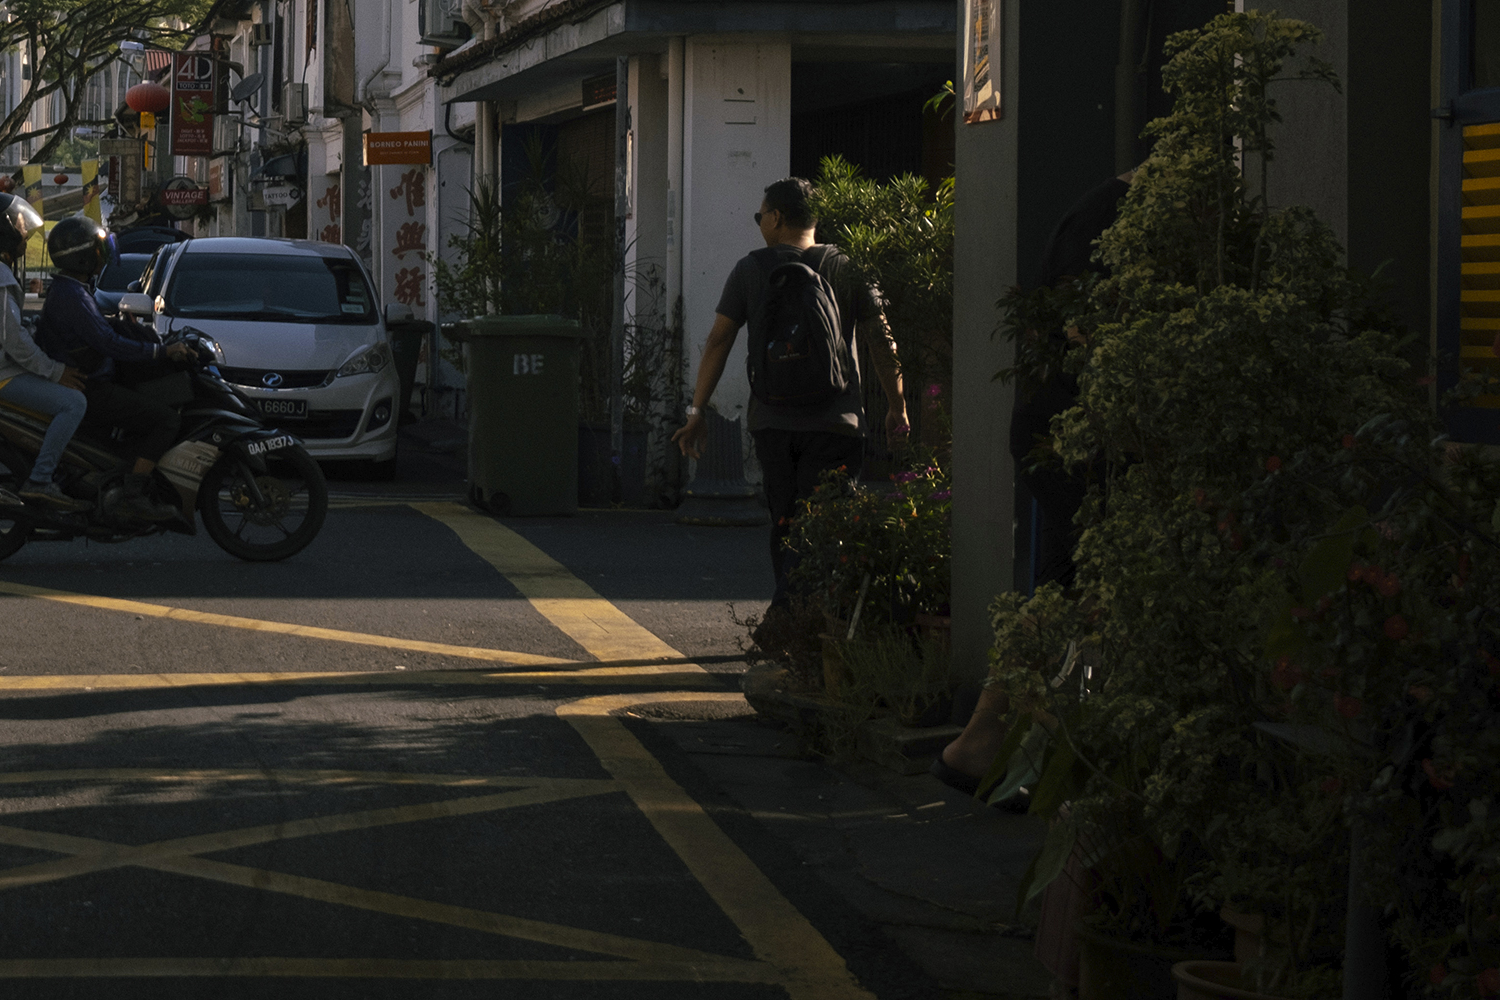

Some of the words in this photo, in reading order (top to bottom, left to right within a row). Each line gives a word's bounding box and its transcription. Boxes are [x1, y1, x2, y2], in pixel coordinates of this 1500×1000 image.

[177, 55, 213, 80] 4D
[165, 190, 204, 199] VINTAGE
[264, 191, 288, 199] TATTOO
[513, 353, 544, 375] BE
[264, 401, 295, 413] 6660
[297, 402, 305, 414] J
